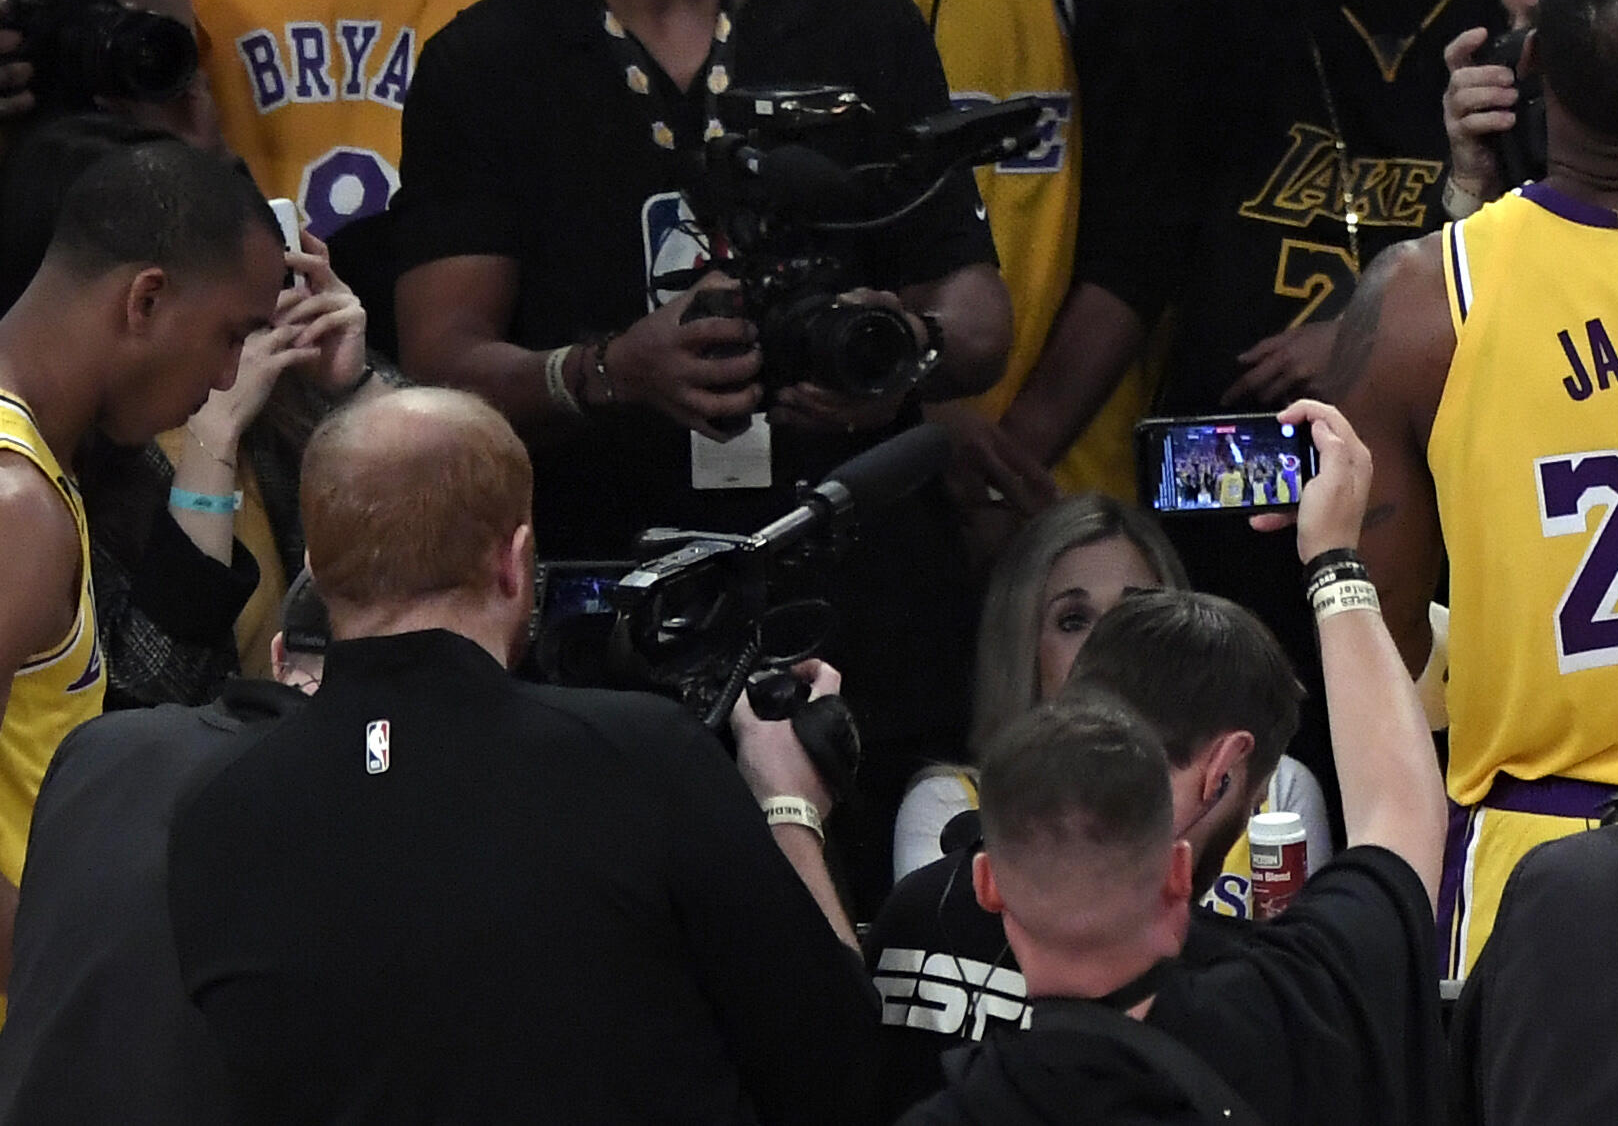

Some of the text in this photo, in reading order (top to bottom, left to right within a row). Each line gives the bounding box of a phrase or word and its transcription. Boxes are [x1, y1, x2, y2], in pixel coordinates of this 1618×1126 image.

[235, 19, 416, 116] BRYA
[1238, 123, 1444, 228] LAKE
[1273, 237, 1362, 331] 2
[871, 947, 1035, 1043] ESP
